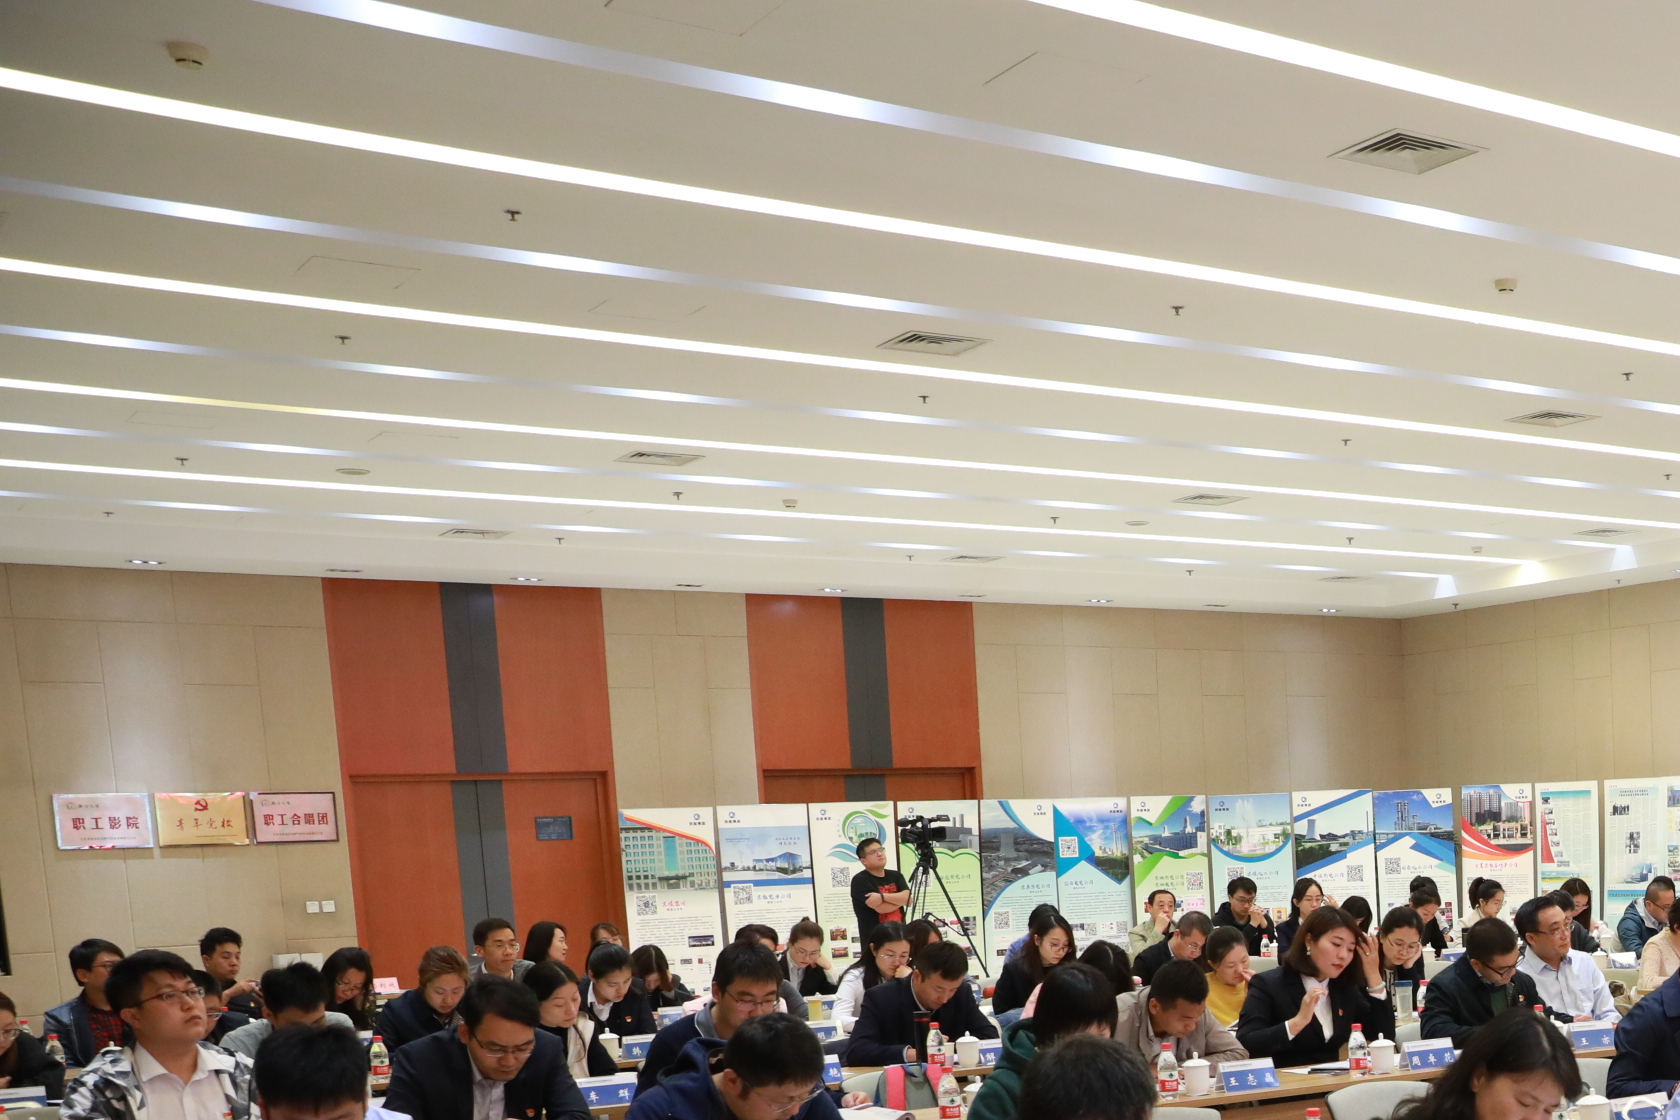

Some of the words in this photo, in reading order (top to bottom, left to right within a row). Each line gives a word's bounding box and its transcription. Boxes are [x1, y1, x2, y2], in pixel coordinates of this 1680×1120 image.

[71, 816, 140, 831] 职工影院
[176, 817, 234, 831] 青年党校
[263, 812, 329, 826] 职工合唱团
[1411, 1051, 1455, 1066] 周卓花
[1229, 1072, 1274, 1087] 王志晶
